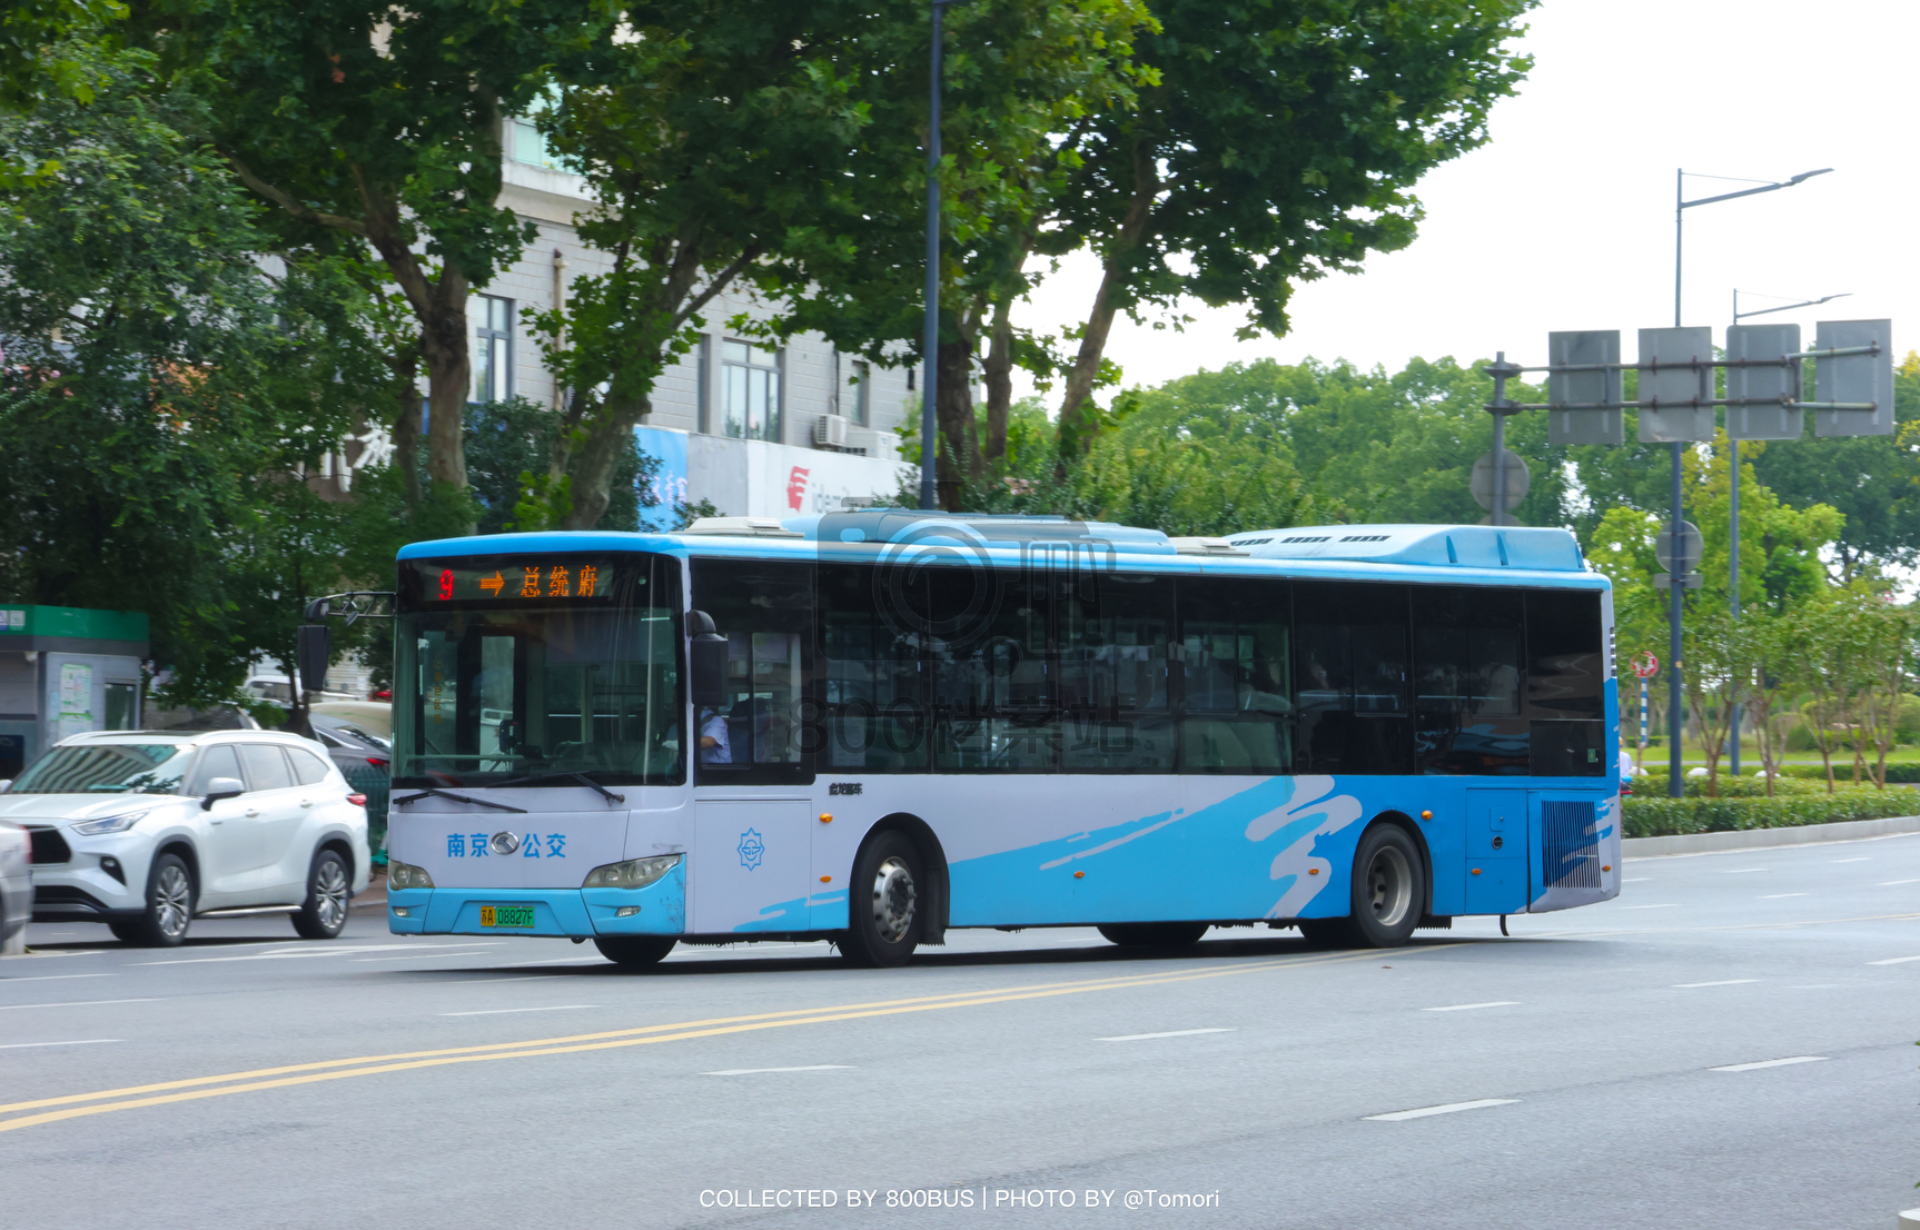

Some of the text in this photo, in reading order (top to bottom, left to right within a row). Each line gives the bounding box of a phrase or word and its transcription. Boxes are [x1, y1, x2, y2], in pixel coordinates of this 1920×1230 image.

[439, 565, 598, 600] 9 总统府
[447, 832, 566, 859] 南京 公交
